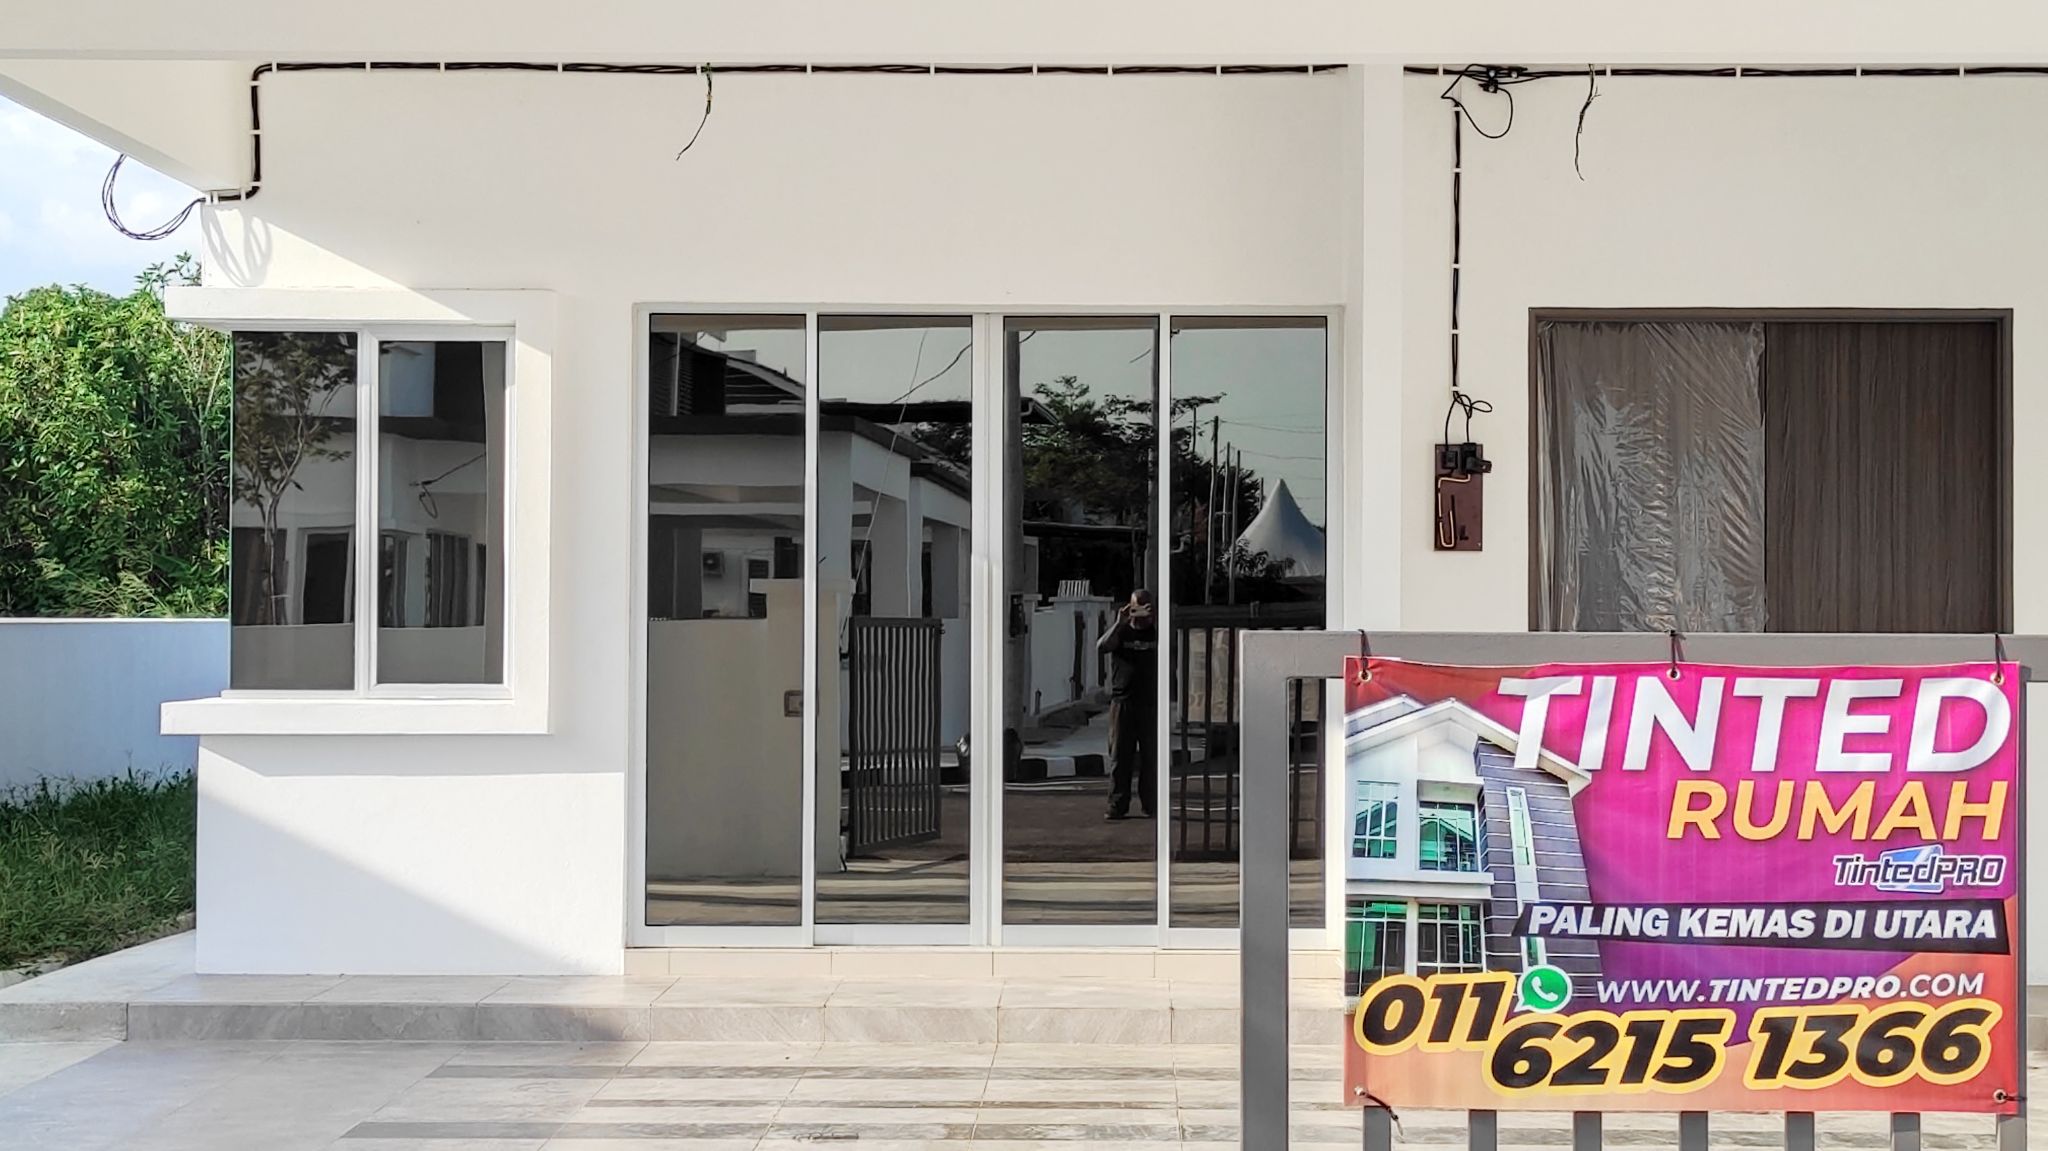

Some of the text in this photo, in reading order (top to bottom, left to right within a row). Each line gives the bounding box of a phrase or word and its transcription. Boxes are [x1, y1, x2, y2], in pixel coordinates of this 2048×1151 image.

[1498, 676, 2012, 773] TINTED
[1667, 780, 2008, 841] RUMAH
[1833, 854, 2006, 886] TintedPRO
[1528, 904, 1997, 940] PALING KEMAS DI UTARA
[1361, 980, 1503, 1046] 011
[1597, 972, 1985, 1003] WWW.TINTEDPRO.COM
[1489, 1007, 1988, 1089] 6215 1366
